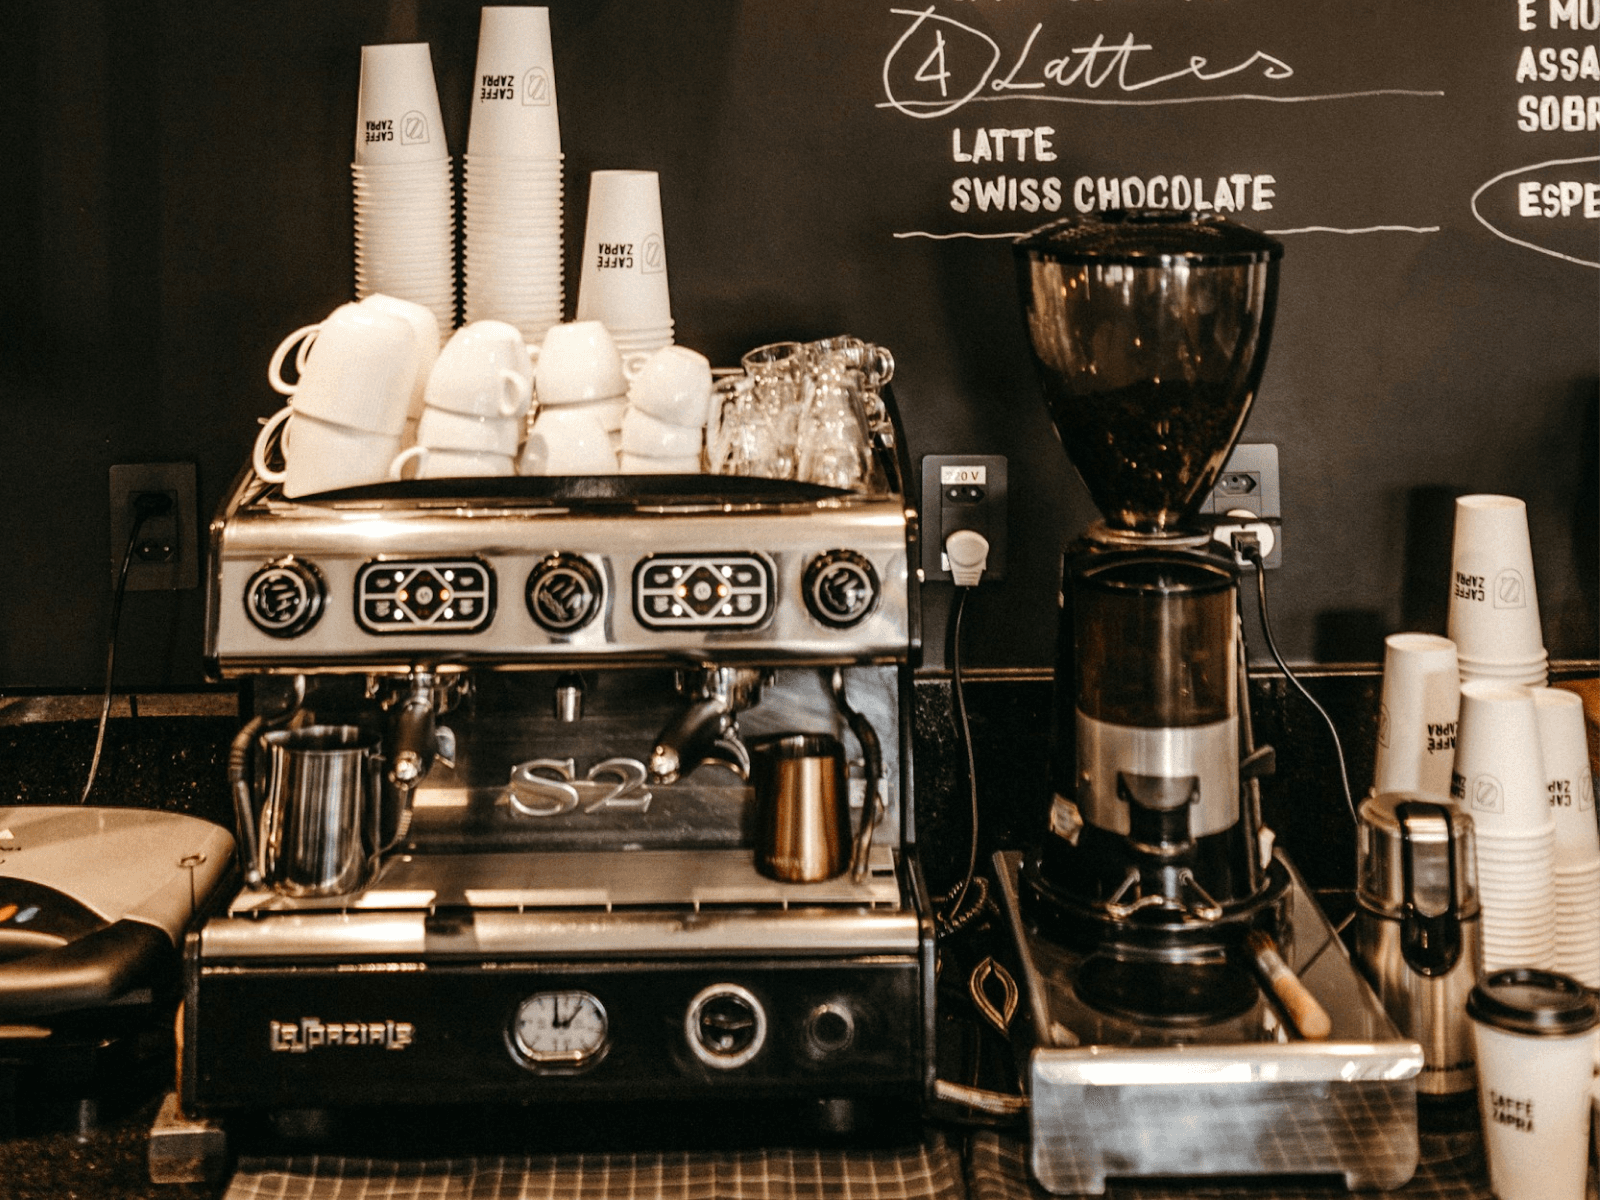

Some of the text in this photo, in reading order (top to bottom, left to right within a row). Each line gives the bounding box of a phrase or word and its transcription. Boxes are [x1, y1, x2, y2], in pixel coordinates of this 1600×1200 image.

[914, 22, 1294, 97] 4 Lattes
[482, 75, 515, 87] ZAPRA
[365, 119, 394, 131] ZAPRA
[952, 125, 1058, 164] LATTE
[950, 173, 1277, 213] SWISS CHOCOLATE
[598, 242, 634, 255] ZAPRA
[971, 471, 979, 481] V
[1427, 736, 1456, 755] AFFÈ
[509, 757, 653, 817] S2
[1547, 780, 1571, 794] ZAP
[1549, 794, 1572, 808] CAF
